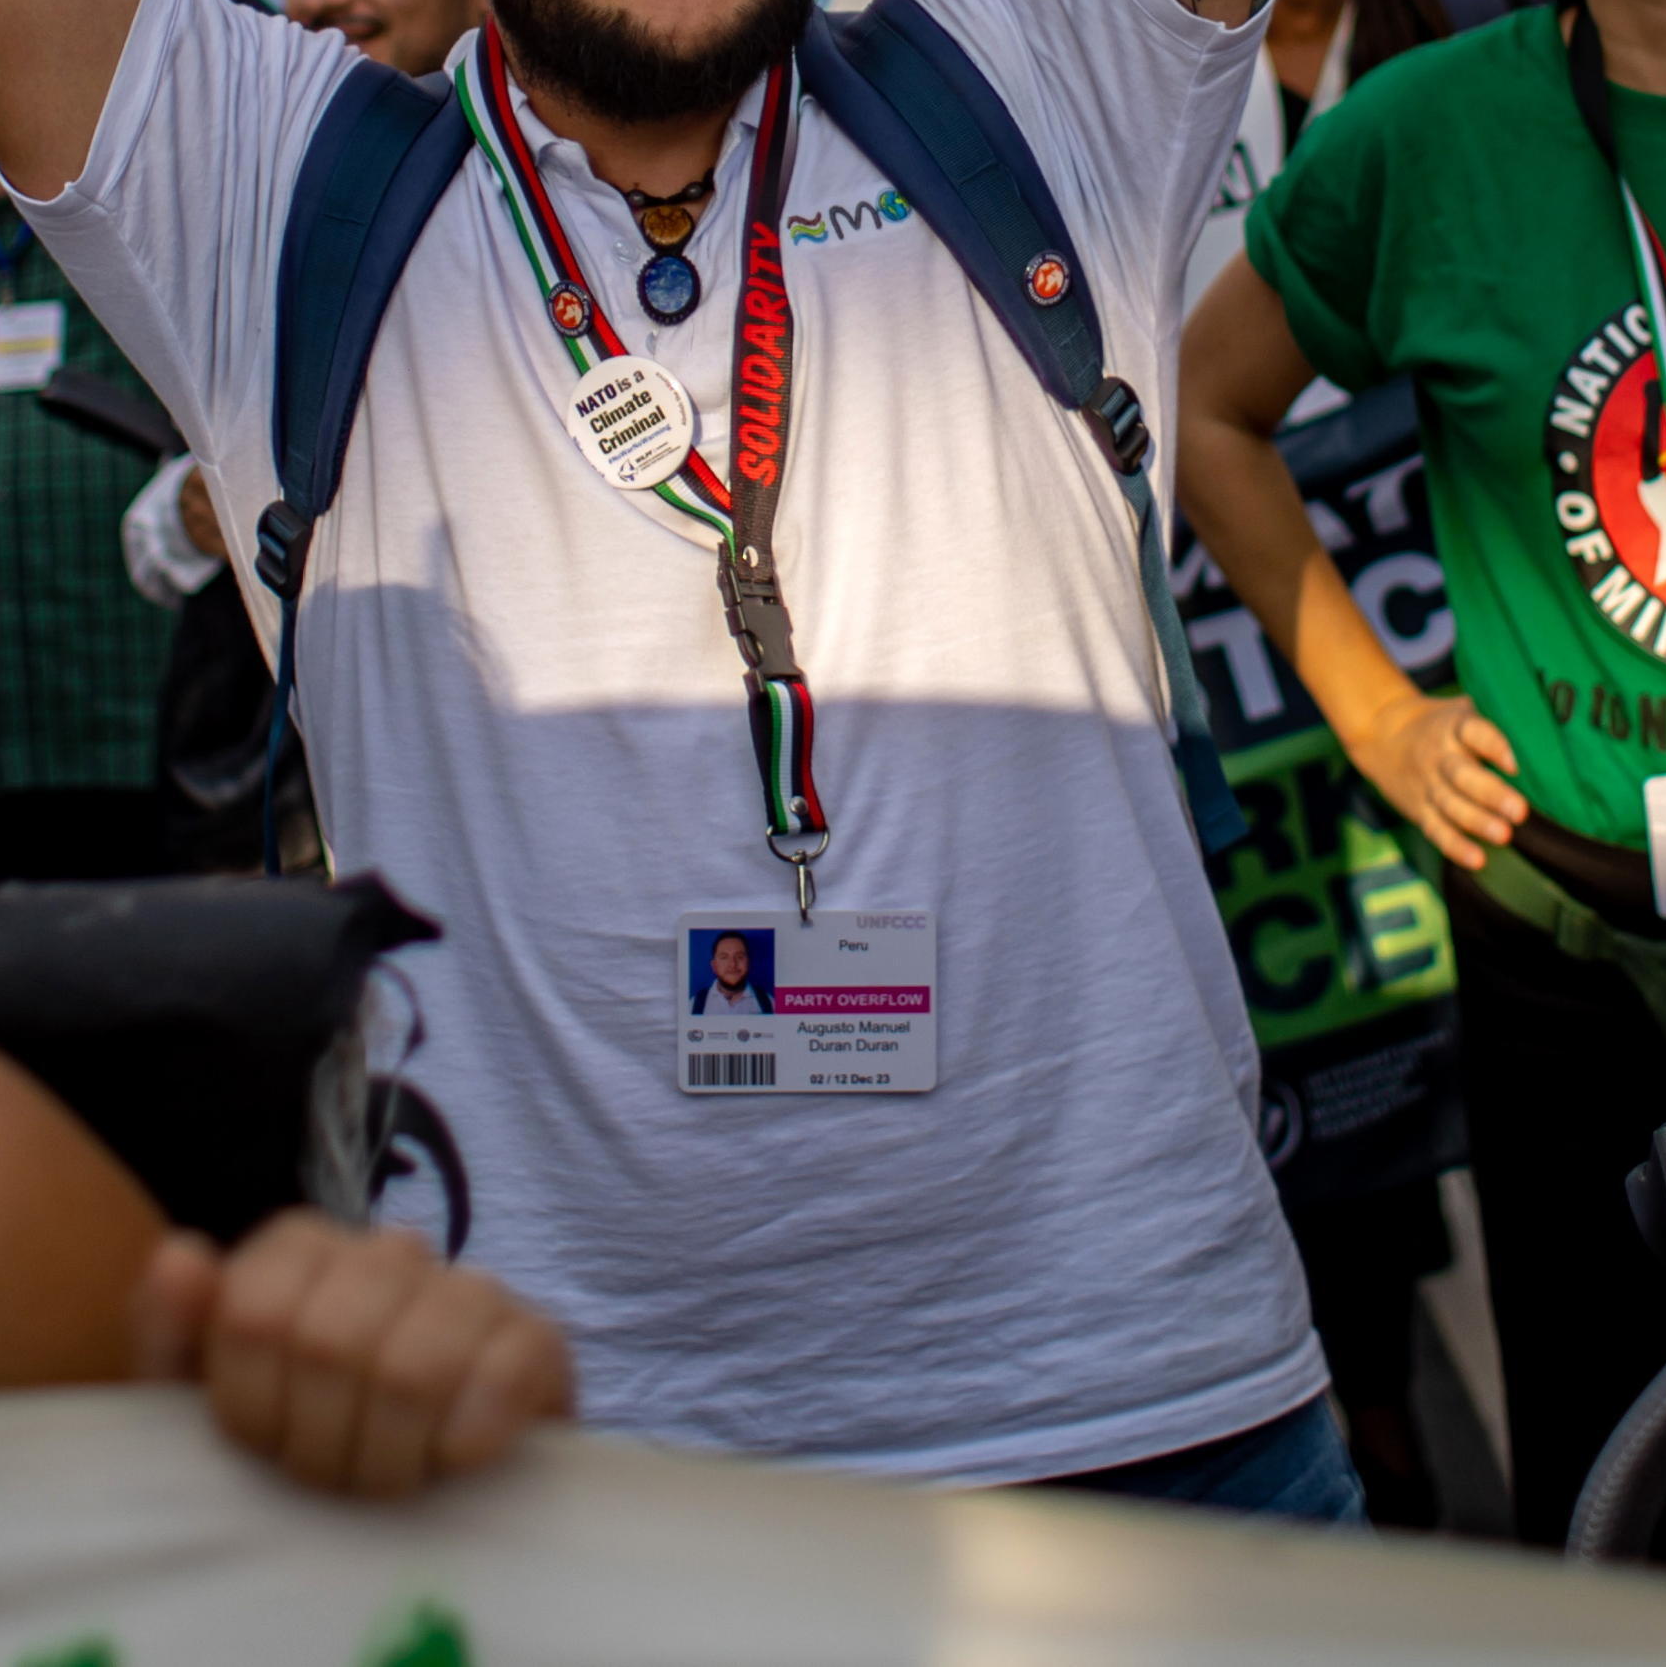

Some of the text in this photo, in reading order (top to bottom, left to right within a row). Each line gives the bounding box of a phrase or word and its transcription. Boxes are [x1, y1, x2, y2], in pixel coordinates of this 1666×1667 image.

[737, 221, 788, 488] SOLIDARITY
[575, 370, 645, 418] NATO is a
[589, 390, 653, 434] Climate
[598, 405, 667, 455] Criminal
[1555, 489, 1615, 565] OF
[856, 916, 926, 929] UNFCCC
[838, 939, 869, 952] Peru
[785, 994, 923, 1007] PARTY OVERFLOW
[797, 1020, 911, 1038] Augusto Manuel
[809, 1038, 899, 1053] Duran Duran
[810, 1074, 824, 1085] 02
[834, 1074, 848, 1085] 12
[851, 1074, 873, 1085] Dec
[876, 1073, 890, 1085] 23
